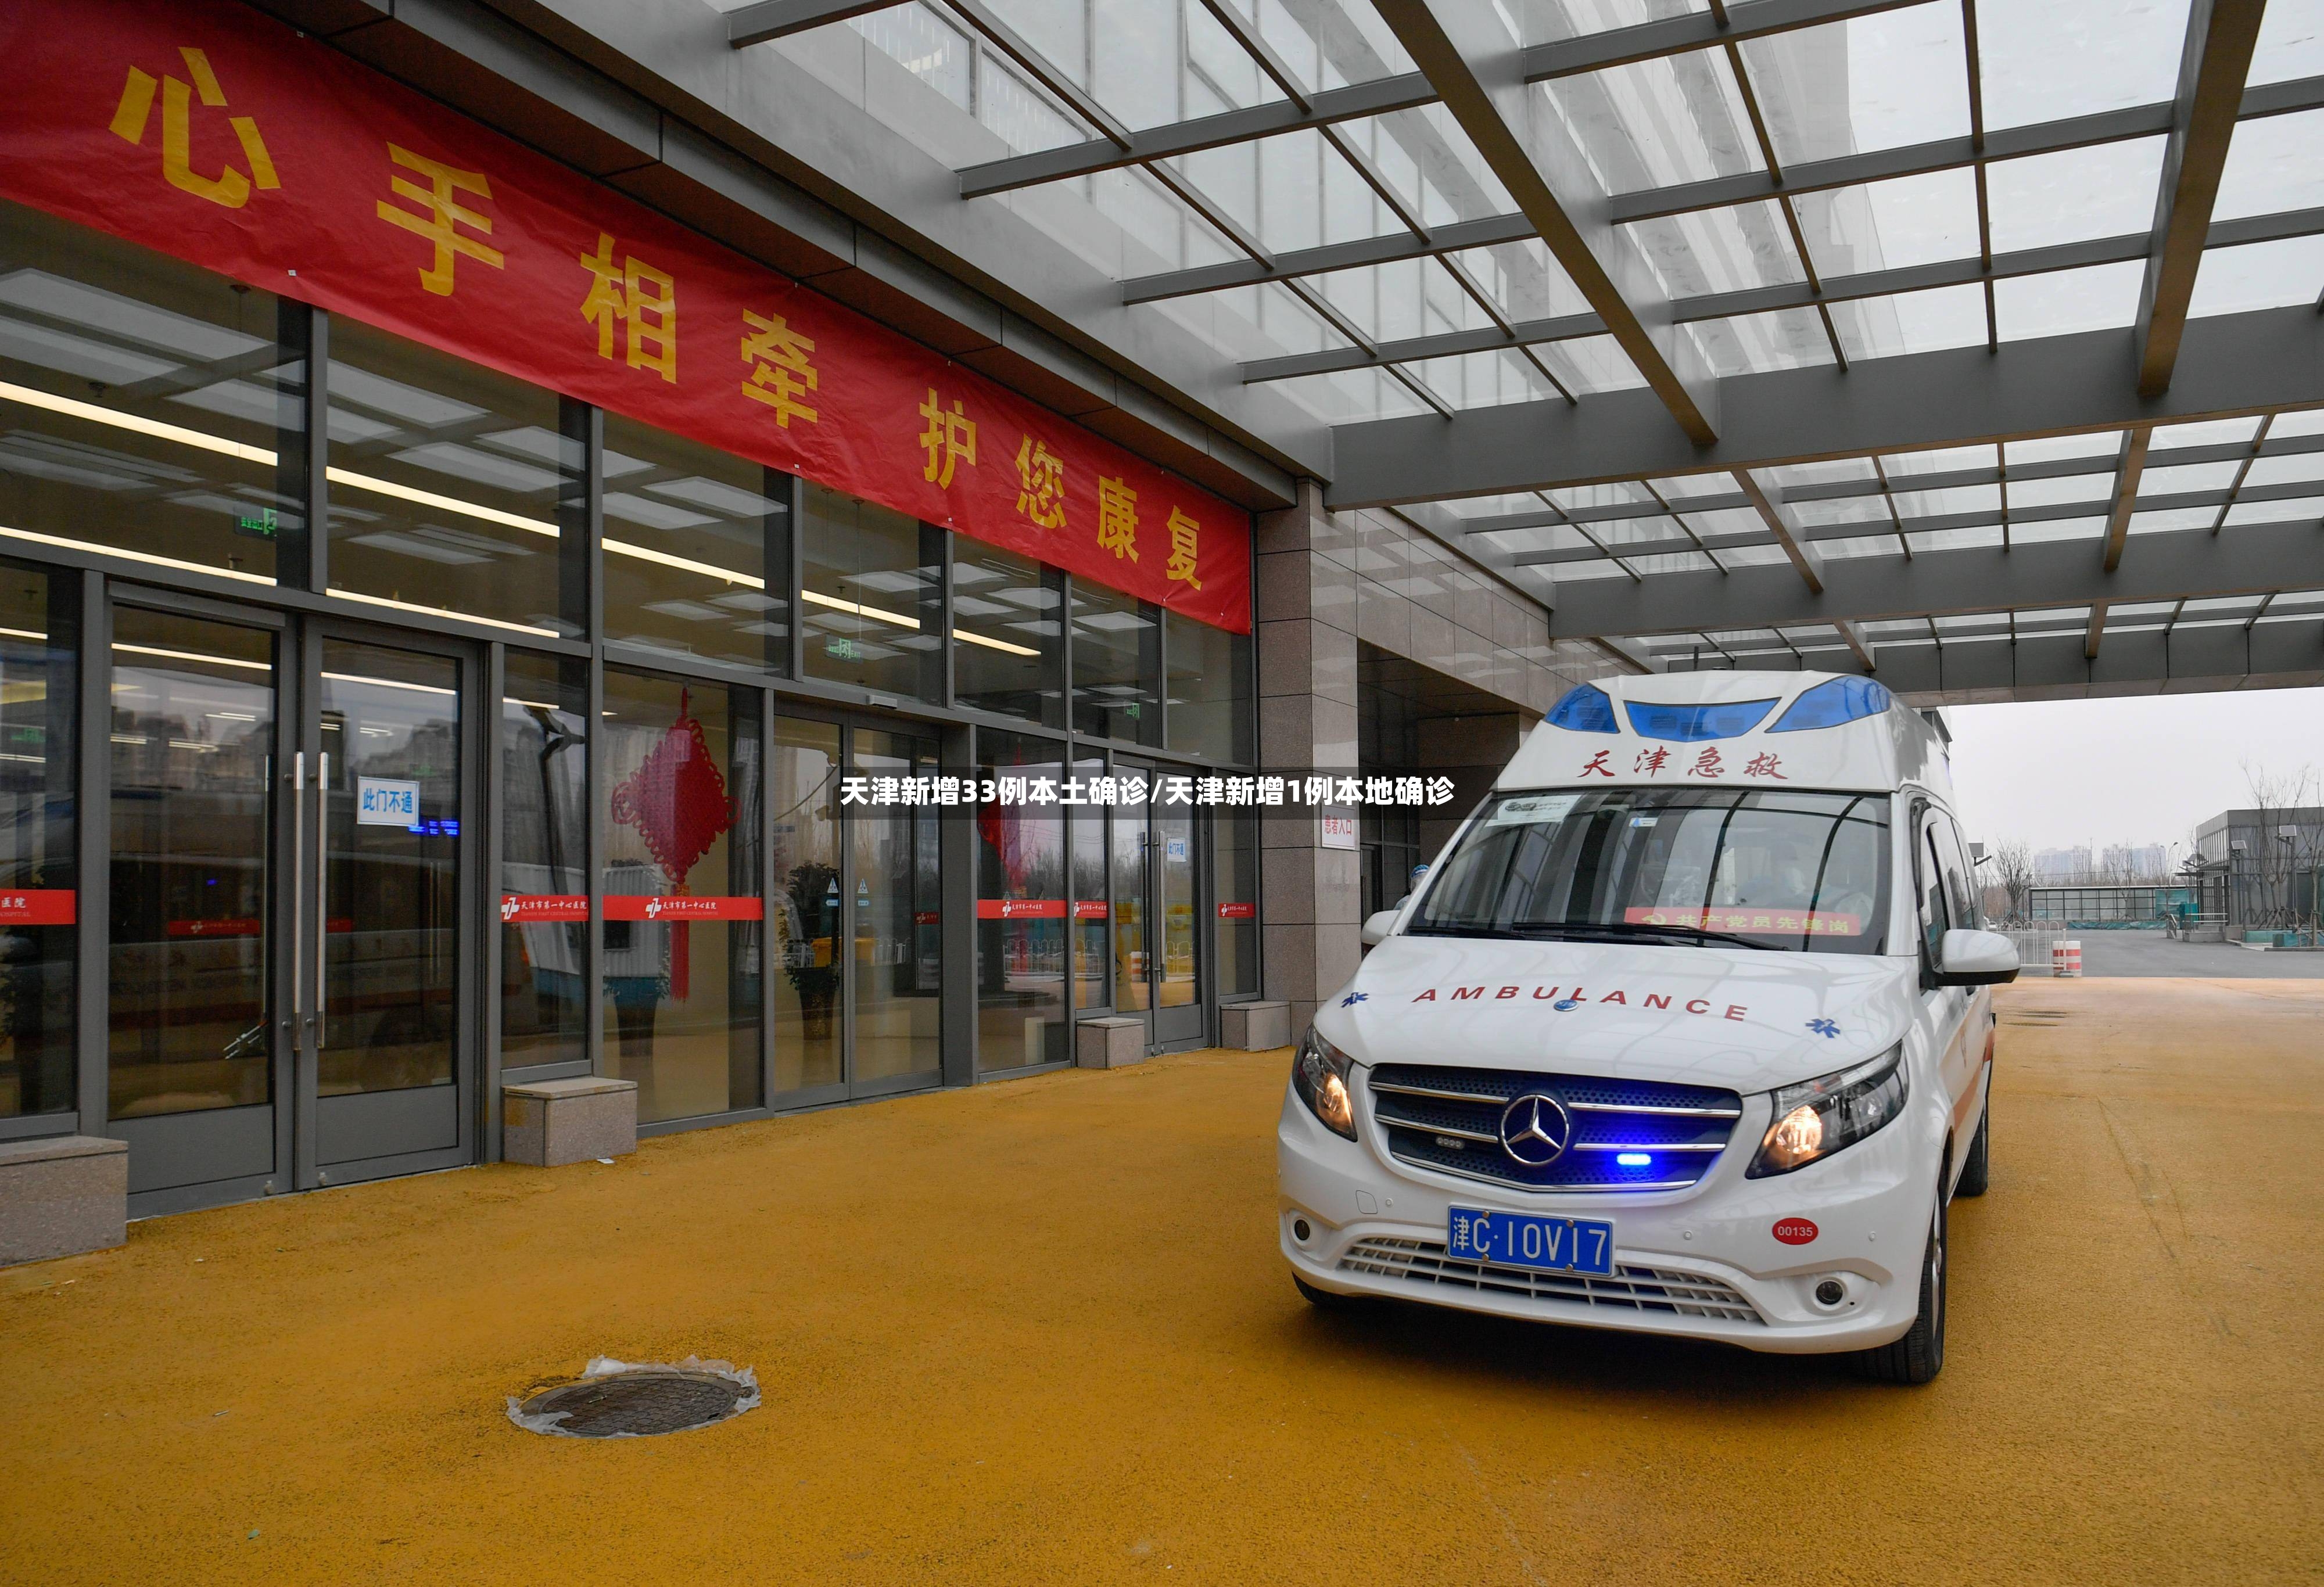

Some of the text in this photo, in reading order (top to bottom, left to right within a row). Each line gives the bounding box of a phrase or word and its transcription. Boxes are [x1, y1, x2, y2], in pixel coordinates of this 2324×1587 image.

[110, 48, 1202, 589] 心手相牵 护您康复
[1577, 745, 1789, 780] 天津急救
[363, 787, 413, 813] 此门不通
[1324, 814, 1352, 835] 患者入口
[1, 897, 26, 908] 医院
[521, 900, 587, 910] 天津市第一中心医院
[662, 901, 716, 910] 天津市第一中心医院
[1675, 915, 1849, 933] 共产党员先锋岗
[1411, 986, 1748, 1021] AMBULANCE
[1778, 1226, 1813, 1237] 00135
